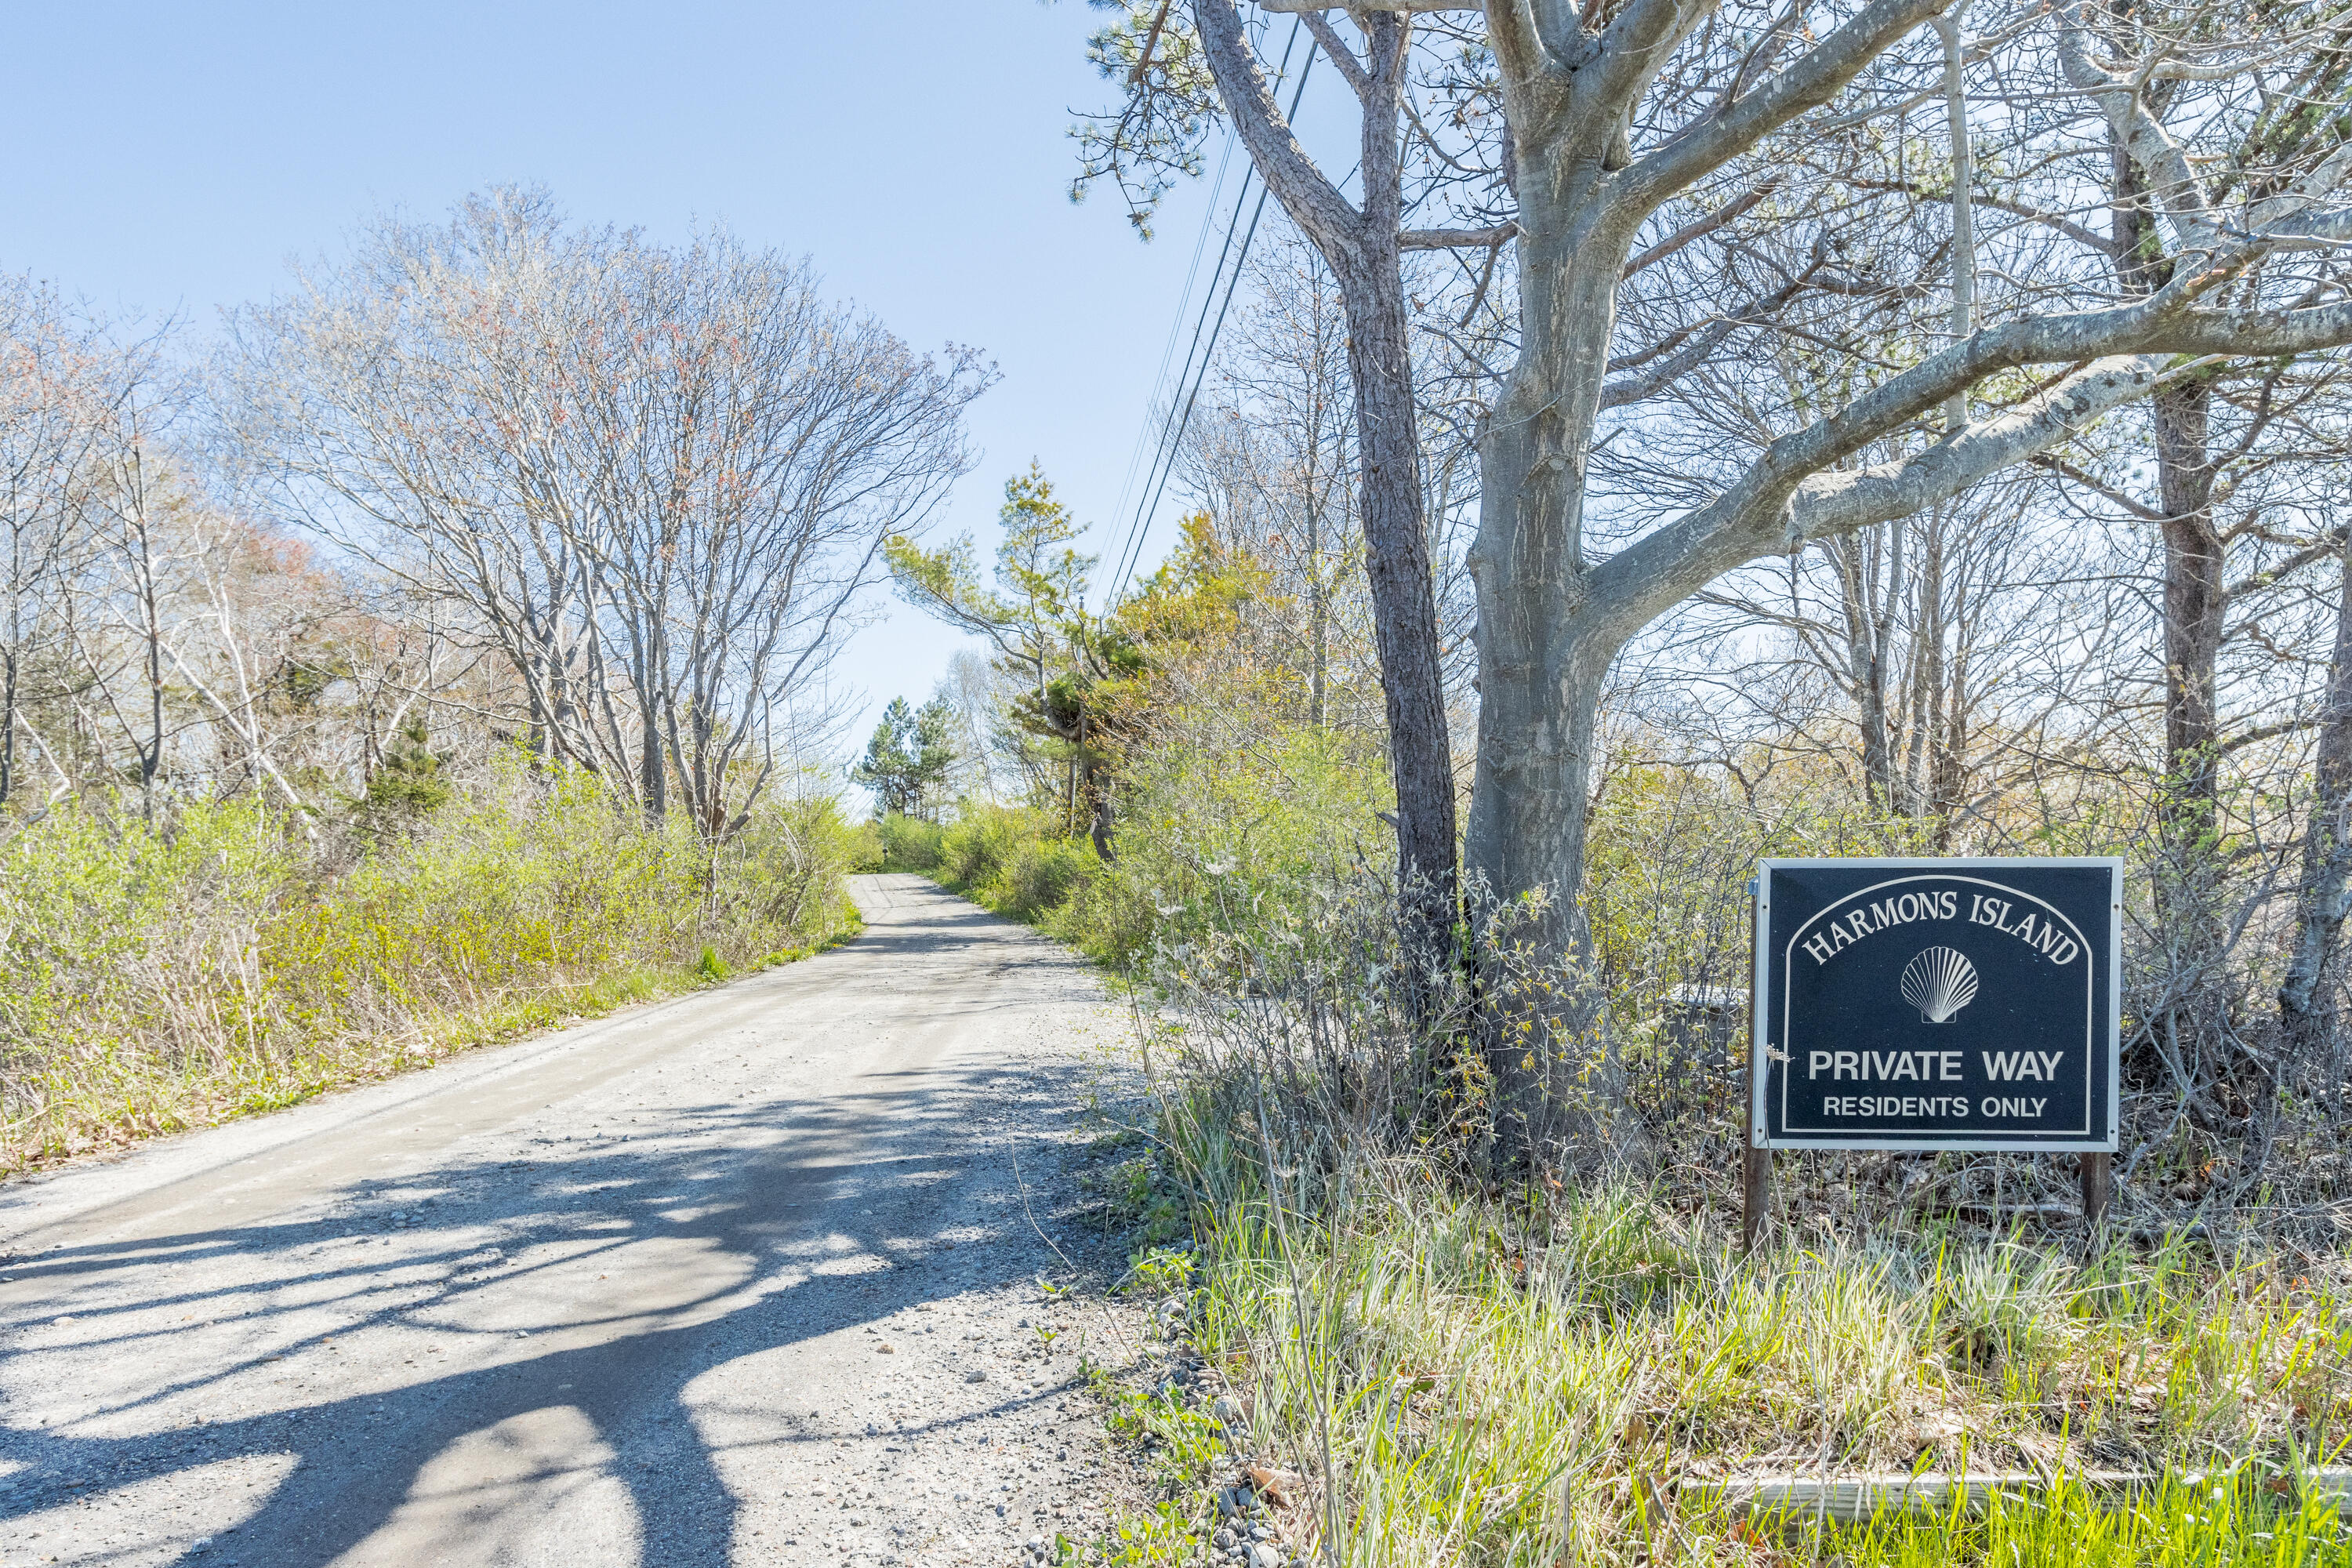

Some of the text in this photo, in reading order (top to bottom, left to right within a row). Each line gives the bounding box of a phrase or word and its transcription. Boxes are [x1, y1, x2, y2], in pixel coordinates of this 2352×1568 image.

[1802, 891, 2079, 965] HARMONS ISLAND
[1809, 1051, 2063, 1081] PRIVATE WAY
[1824, 1097, 2048, 1117] RESIDENTS ONLY
